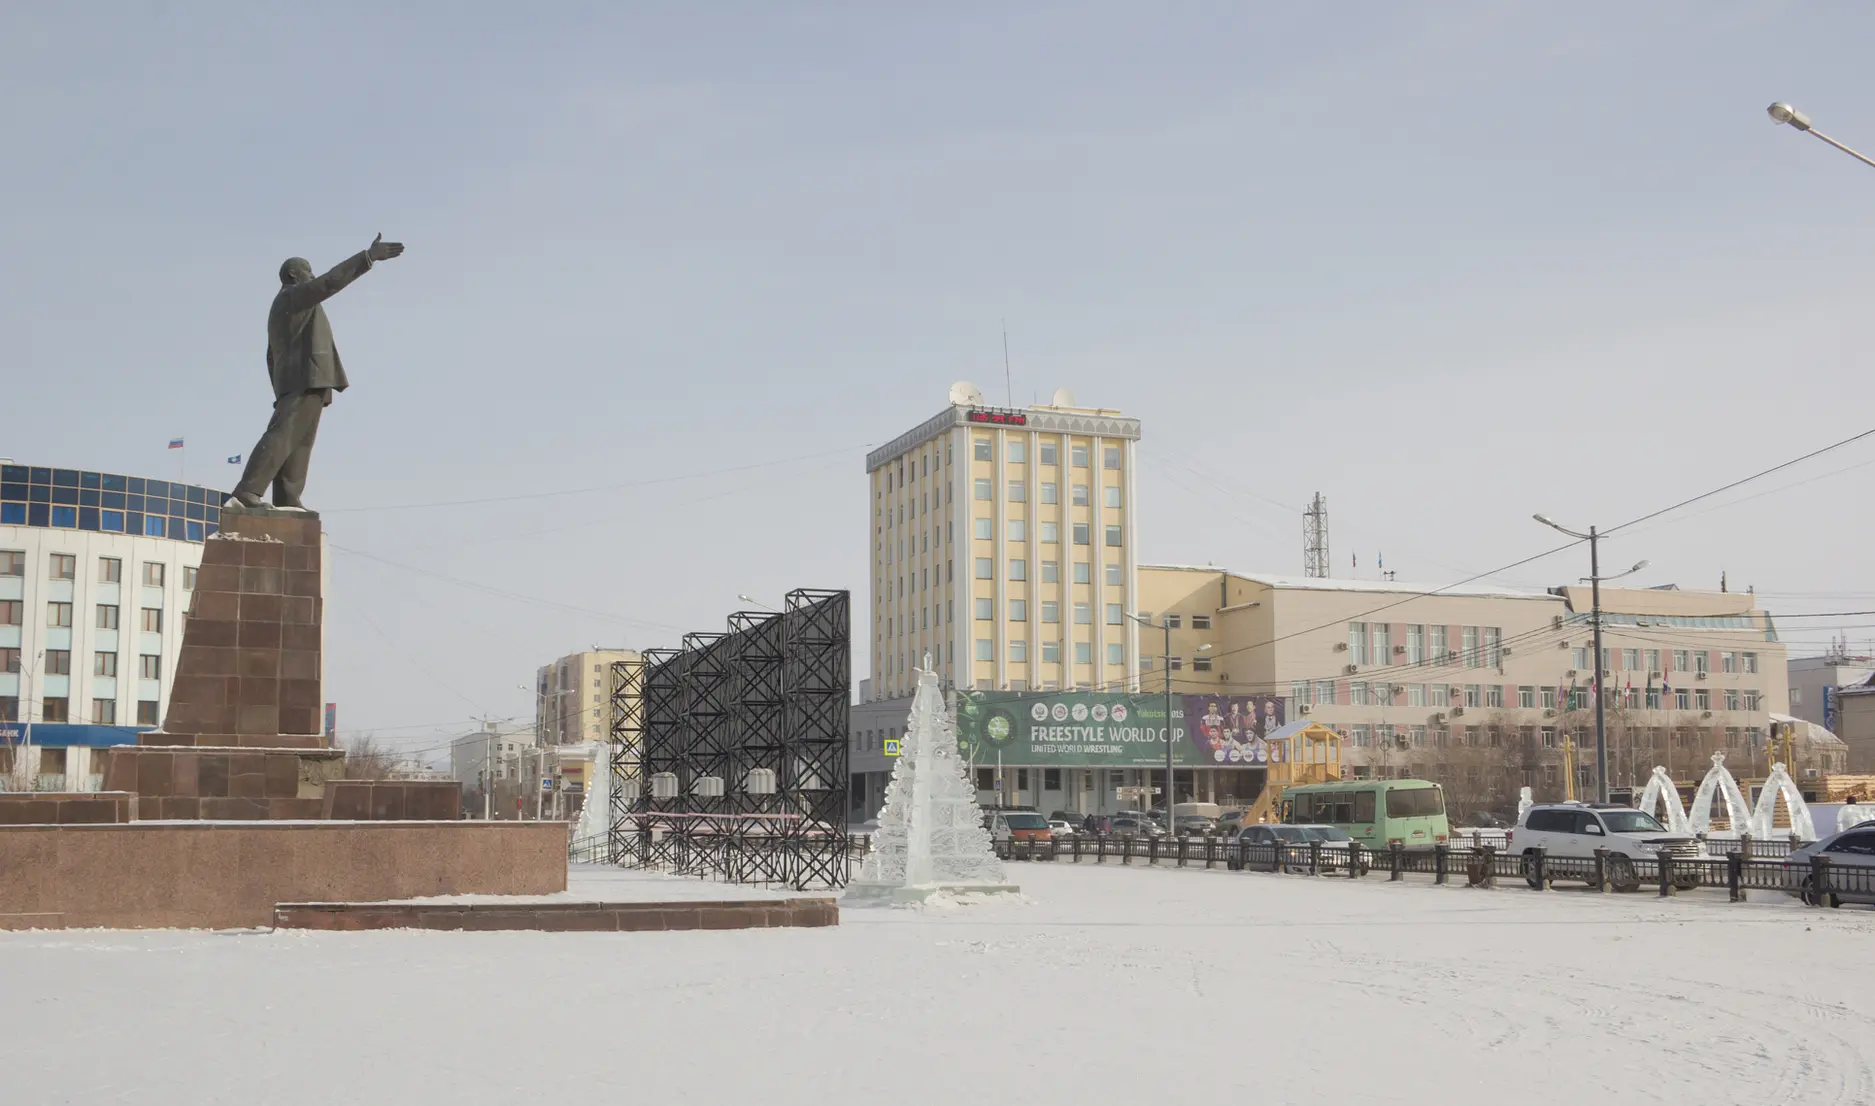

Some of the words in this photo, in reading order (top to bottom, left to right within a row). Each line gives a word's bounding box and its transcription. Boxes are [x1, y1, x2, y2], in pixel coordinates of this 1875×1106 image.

[1171, 710, 1184, 719] 019
[1031, 726, 1105, 742] FREESTYLE
[1109, 727, 1156, 743] WORLD
[1159, 727, 1184, 743] CUP
[1031, 744, 1057, 753] UNITED
[1057, 744, 1083, 753] WORLD
[1084, 745, 1123, 753] WRESTLING
